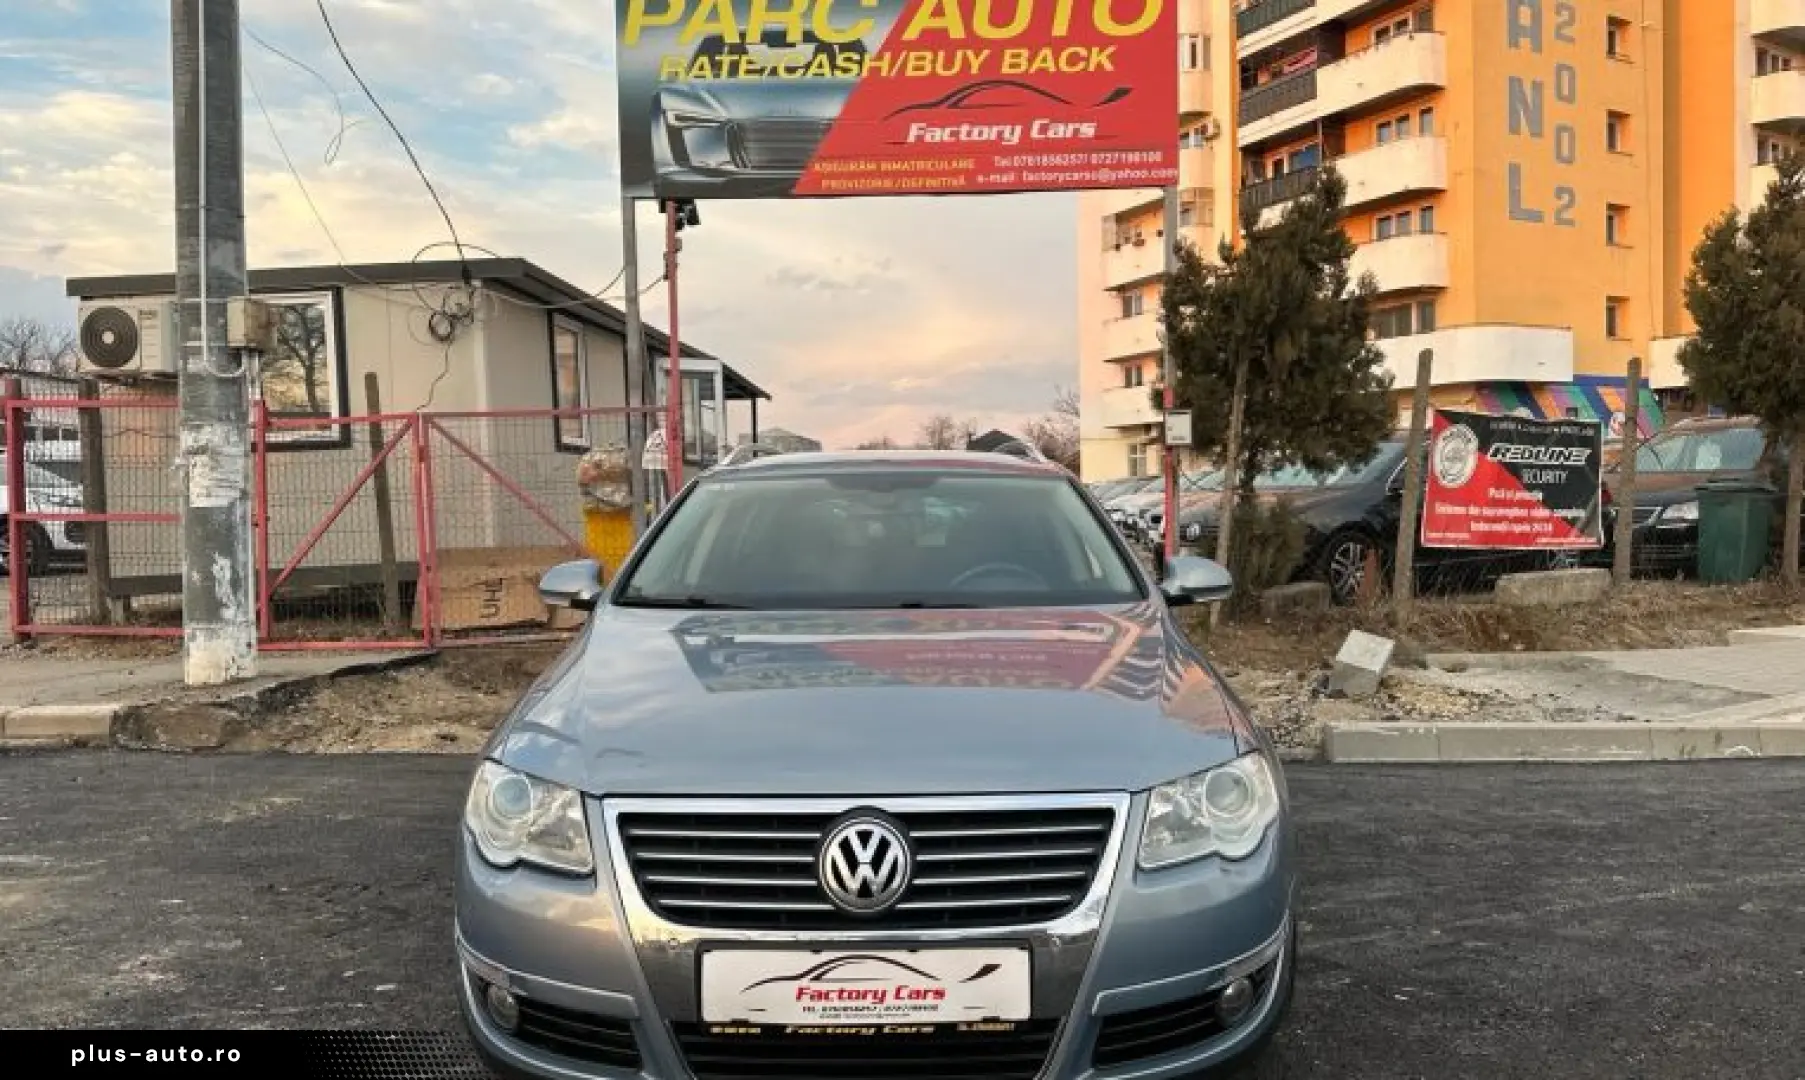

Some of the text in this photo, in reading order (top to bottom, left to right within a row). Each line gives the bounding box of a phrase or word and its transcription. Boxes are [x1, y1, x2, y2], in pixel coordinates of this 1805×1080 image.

[623, 0, 879, 46] PARC
[659, 45, 1118, 81] RATE/CASH/BUY BACK
[906, 118, 1098, 145] Factory Cars
[1553, 1, 1577, 228] 2002
[795, 984, 946, 1004] Factory Cars
